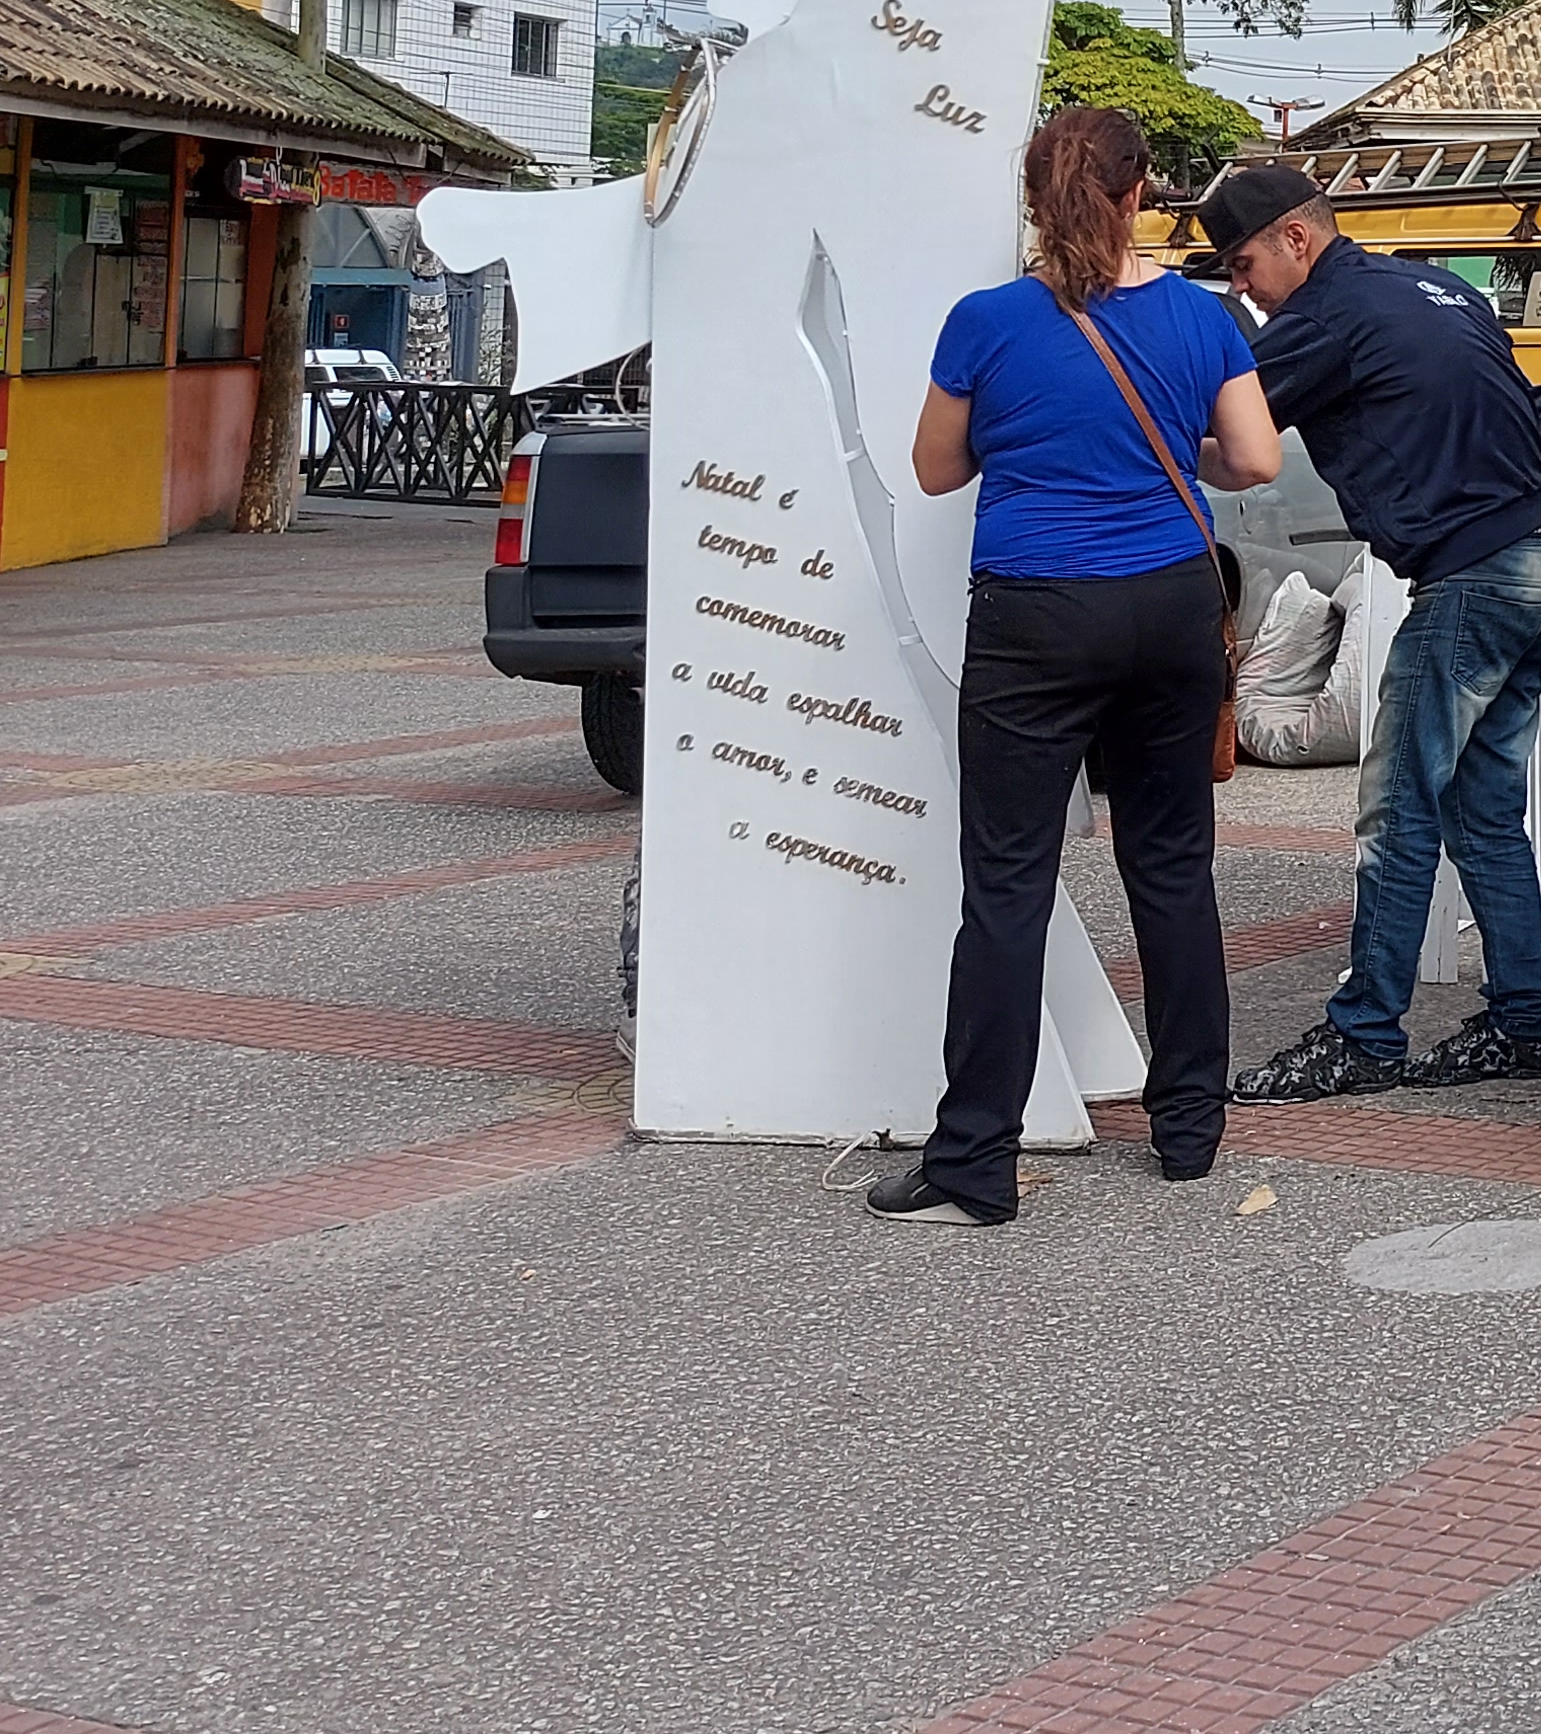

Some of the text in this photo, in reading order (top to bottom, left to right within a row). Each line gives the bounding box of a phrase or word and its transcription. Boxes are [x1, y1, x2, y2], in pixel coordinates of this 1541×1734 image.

[914, 84, 987, 134] Luz
[681, 459, 800, 510] Natal é
[698, 525, 835, 580] tempo de
[695, 595, 847, 651] comemorar
[671, 662, 904, 737] a vida espalhar
[676, 732, 696, 752] o
[712, 740, 793, 783] amor,
[802, 766, 819, 785] e
[729, 819, 907, 885] a esperança.
